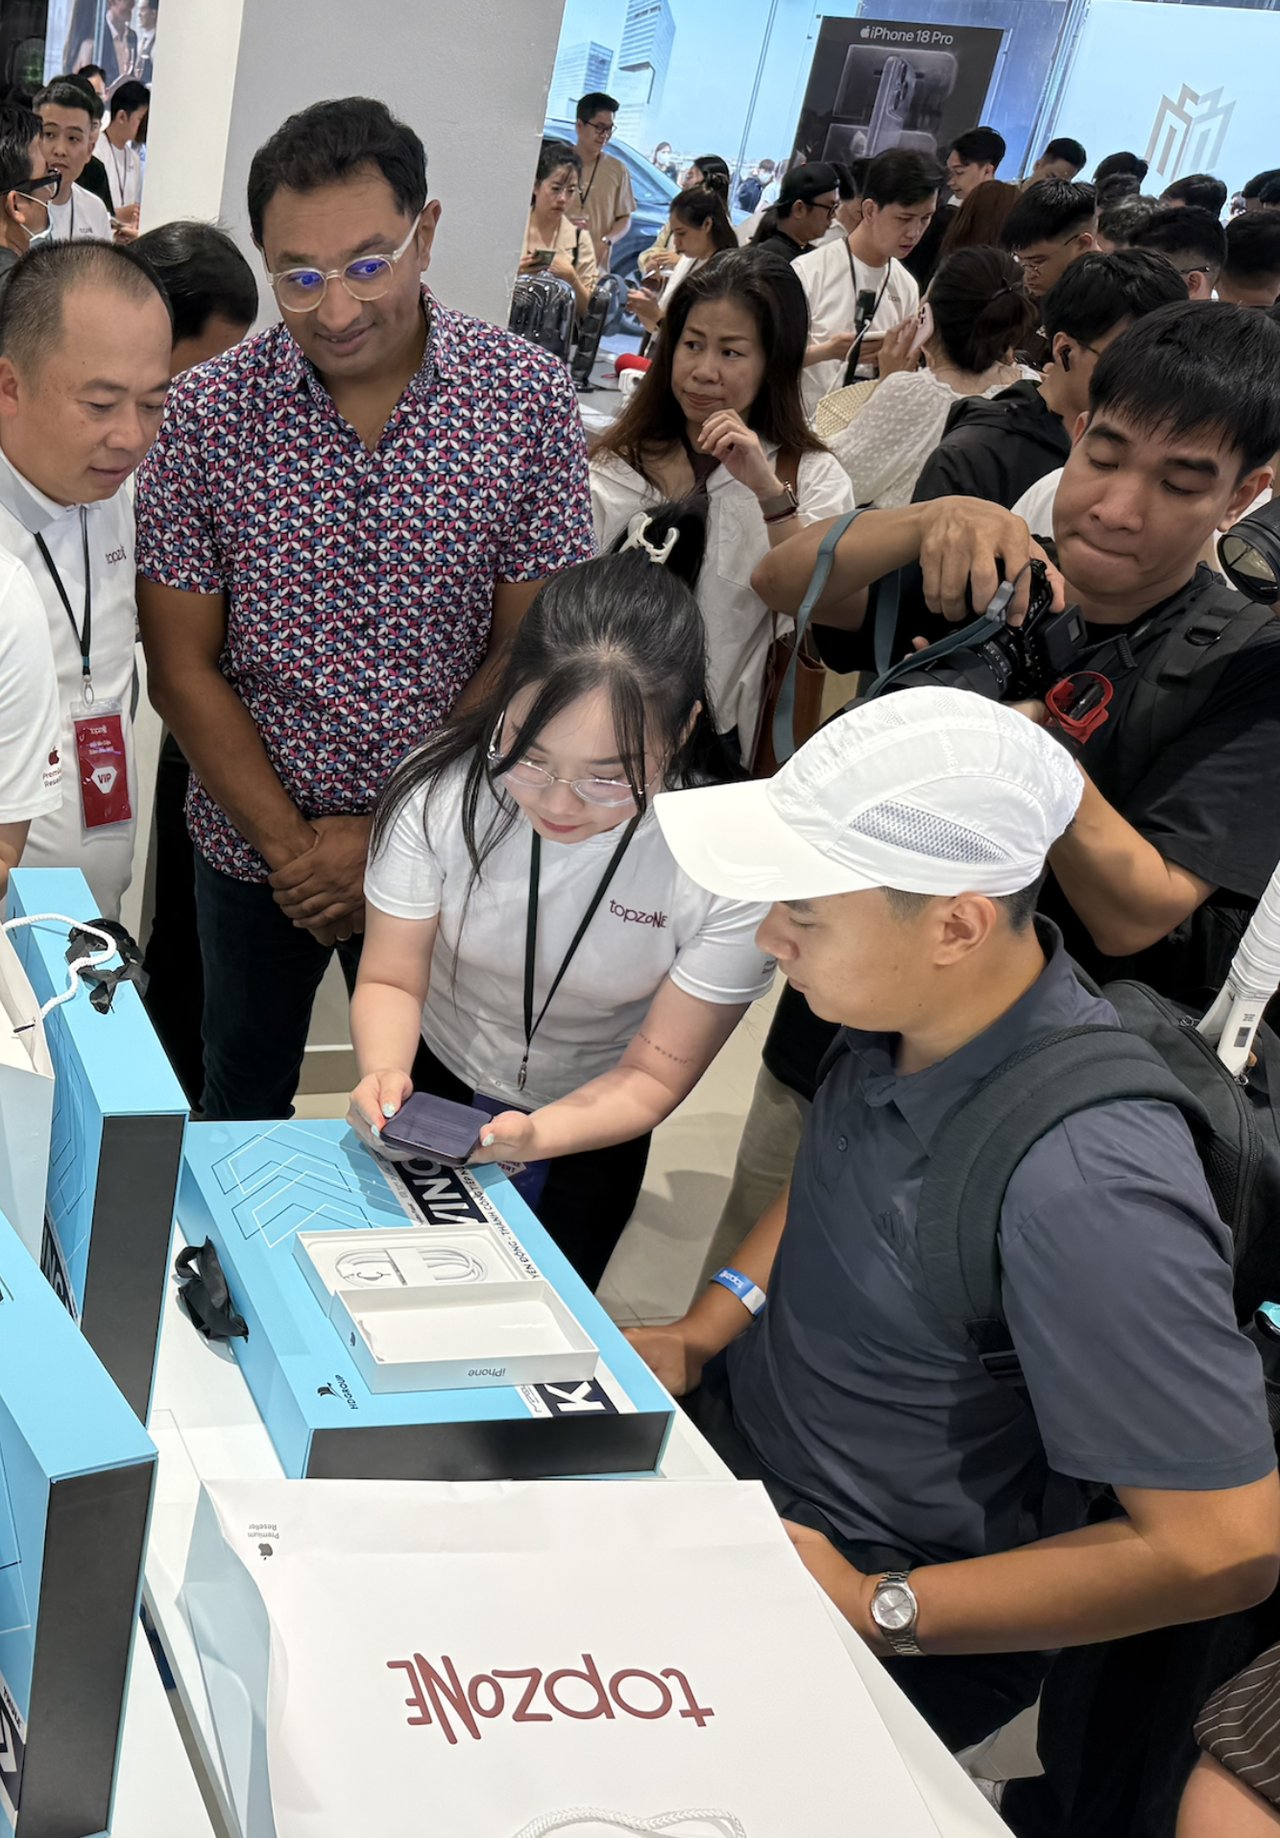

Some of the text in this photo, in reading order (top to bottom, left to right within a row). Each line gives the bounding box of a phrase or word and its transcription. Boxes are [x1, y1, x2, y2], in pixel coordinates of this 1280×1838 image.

[870, 26, 954, 45] iPhone 18 Pro
[97, 772, 112, 784] VIP
[468, 1367, 506, 1378] iPhone
[335, 1374, 358, 1410] HDGROUP
